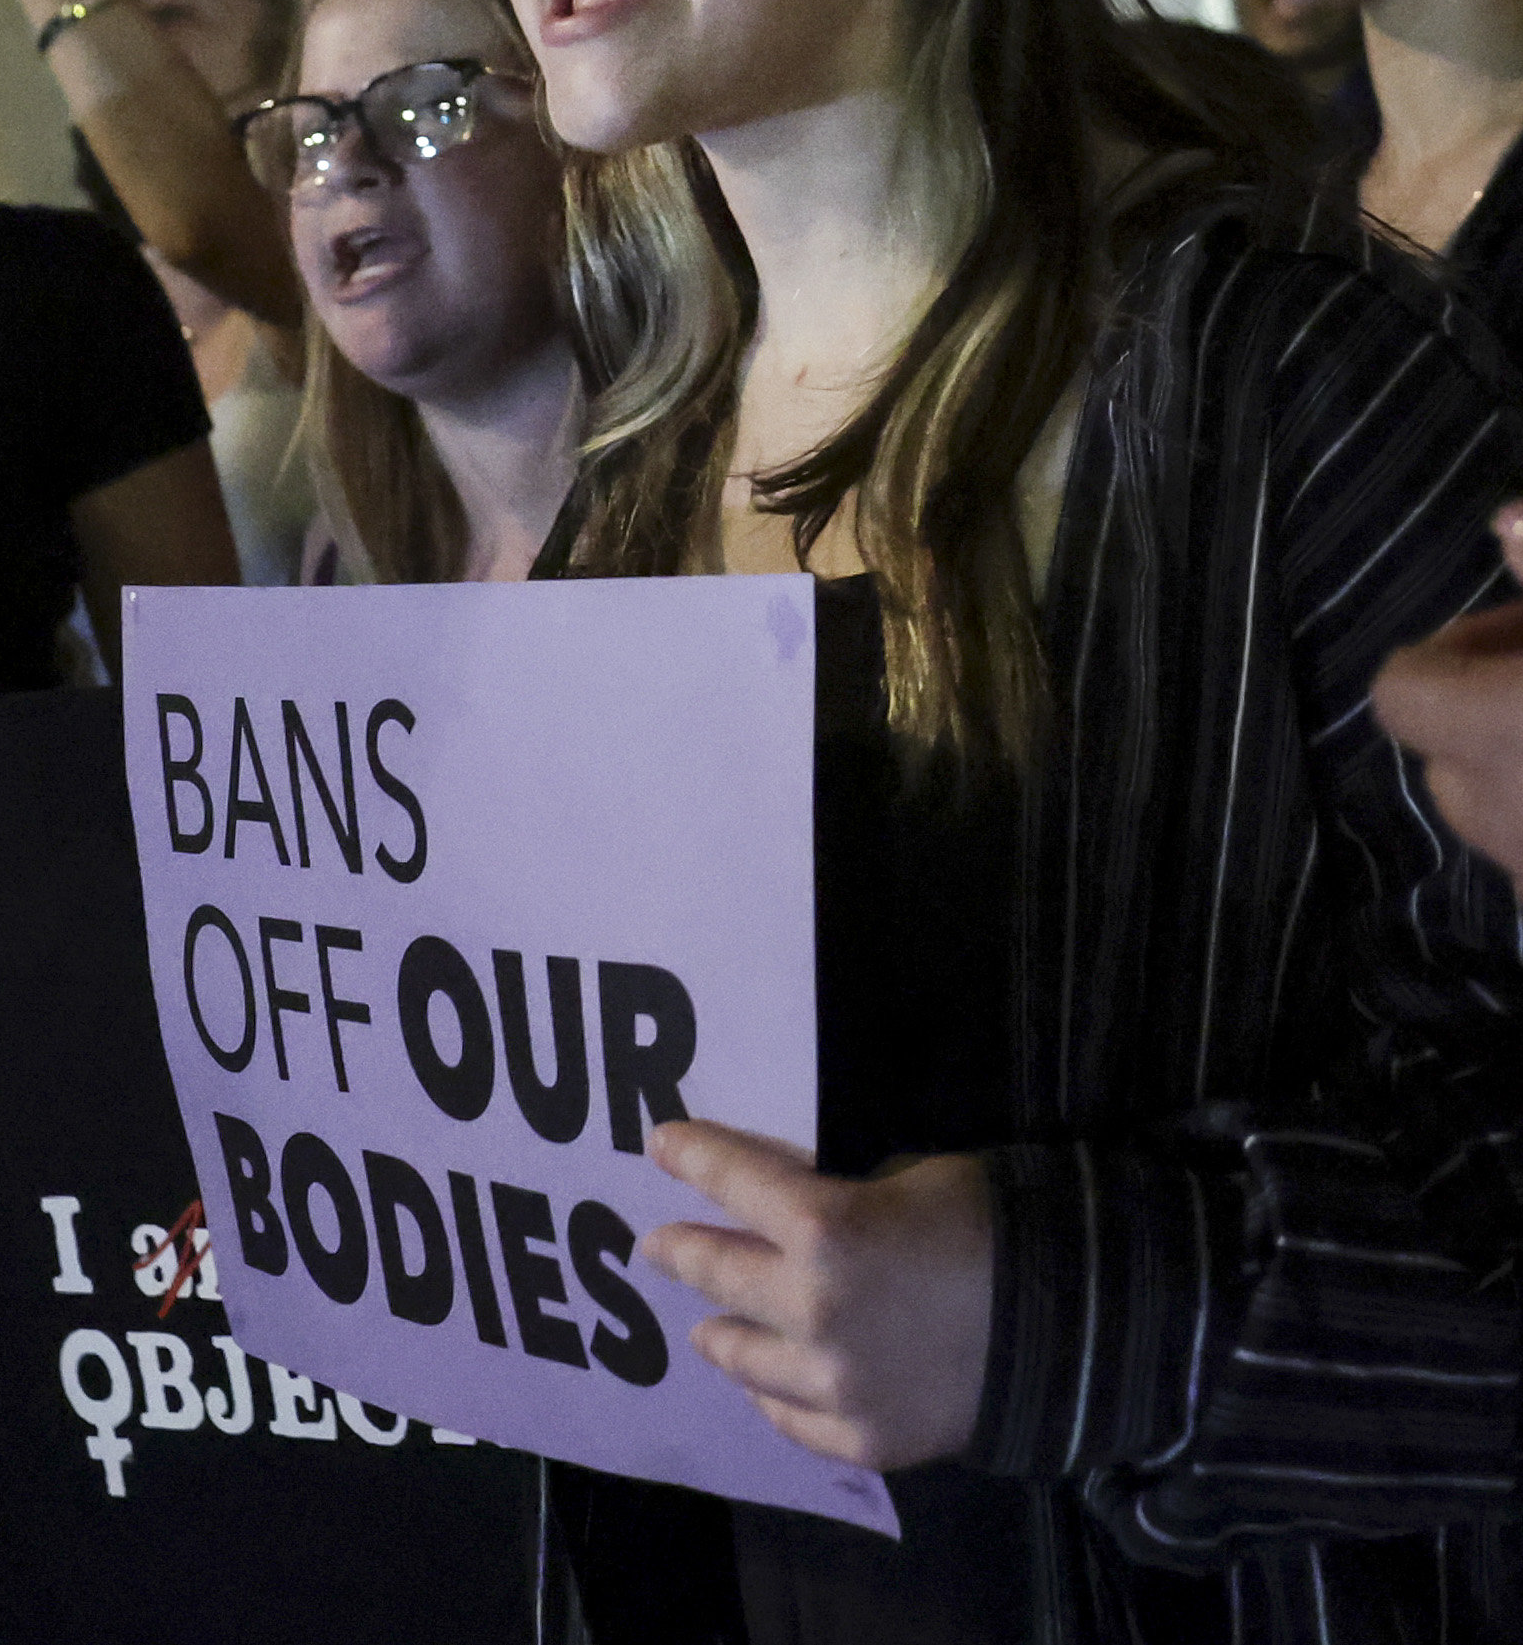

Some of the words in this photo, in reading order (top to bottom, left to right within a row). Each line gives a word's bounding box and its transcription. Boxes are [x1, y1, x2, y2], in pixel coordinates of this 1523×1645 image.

[156, 693, 428, 884] BANS
[183, 904, 371, 1093] OFF
[397, 935, 697, 1156] OUR
[41, 1196, 94, 1294] I
[213, 1111, 670, 1388] BODIES
